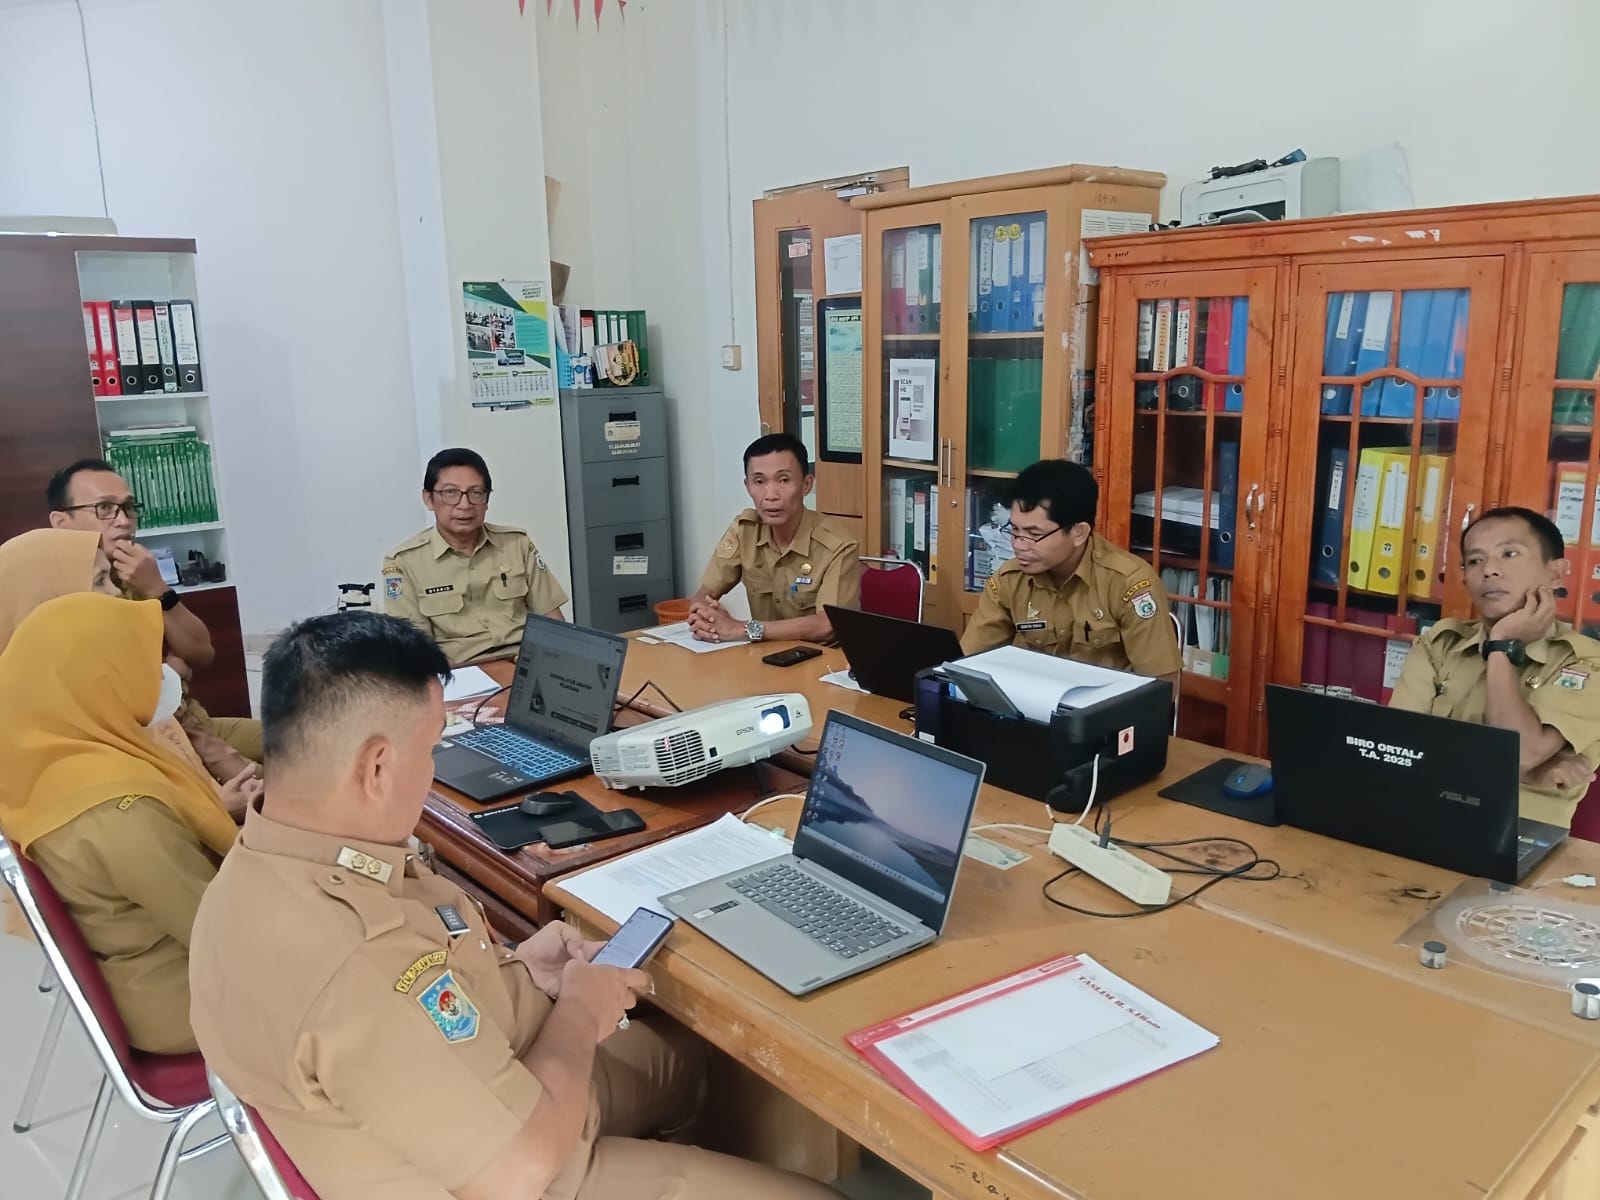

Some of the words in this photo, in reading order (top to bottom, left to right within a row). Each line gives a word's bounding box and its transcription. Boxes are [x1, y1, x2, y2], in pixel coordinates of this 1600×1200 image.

[736, 725, 754, 736] EPSON
[1346, 736, 1375, 749] BIRO
[1358, 748, 1380, 761] T.A.
[1383, 754, 1413, 768] 2025
[1077, 975, 1115, 1001] TASLIM
